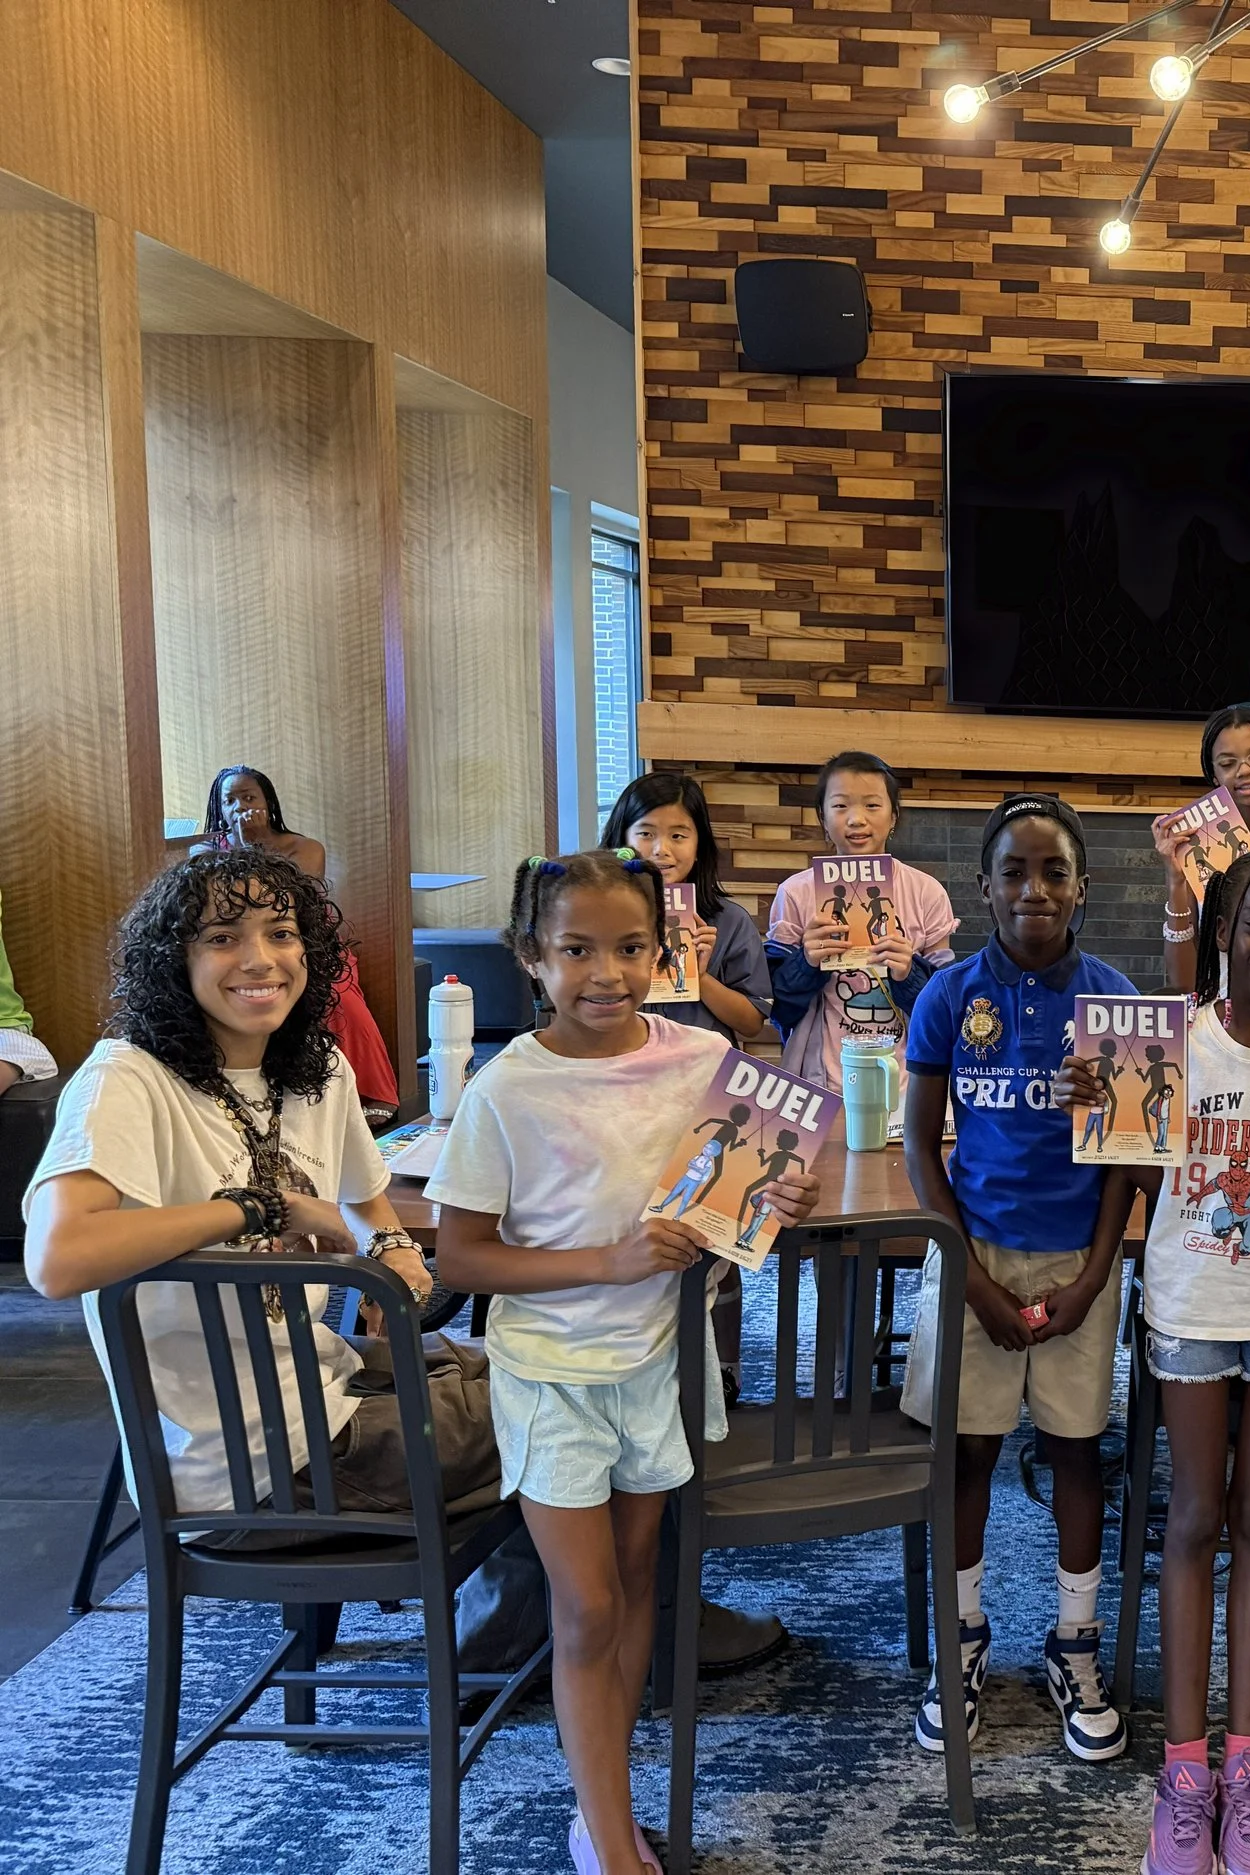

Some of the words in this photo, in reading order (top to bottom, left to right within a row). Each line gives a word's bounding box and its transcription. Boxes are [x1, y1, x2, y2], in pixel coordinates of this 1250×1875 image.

[822, 860, 887, 884] DUEL
[663, 887, 687, 911] EL
[1086, 1003, 1175, 1039] DUEL
[957, 1066, 1016, 1077] CHALLENGE
[1018, 1067, 1040, 1077] CUP
[724, 1060, 825, 1133] DUEL
[956, 1076, 1016, 1109] PRL
[1198, 1091, 1245, 1117] NEW
[1179, 1209, 1212, 1223] FIGHT
[1187, 1236, 1231, 1254] Spidey
